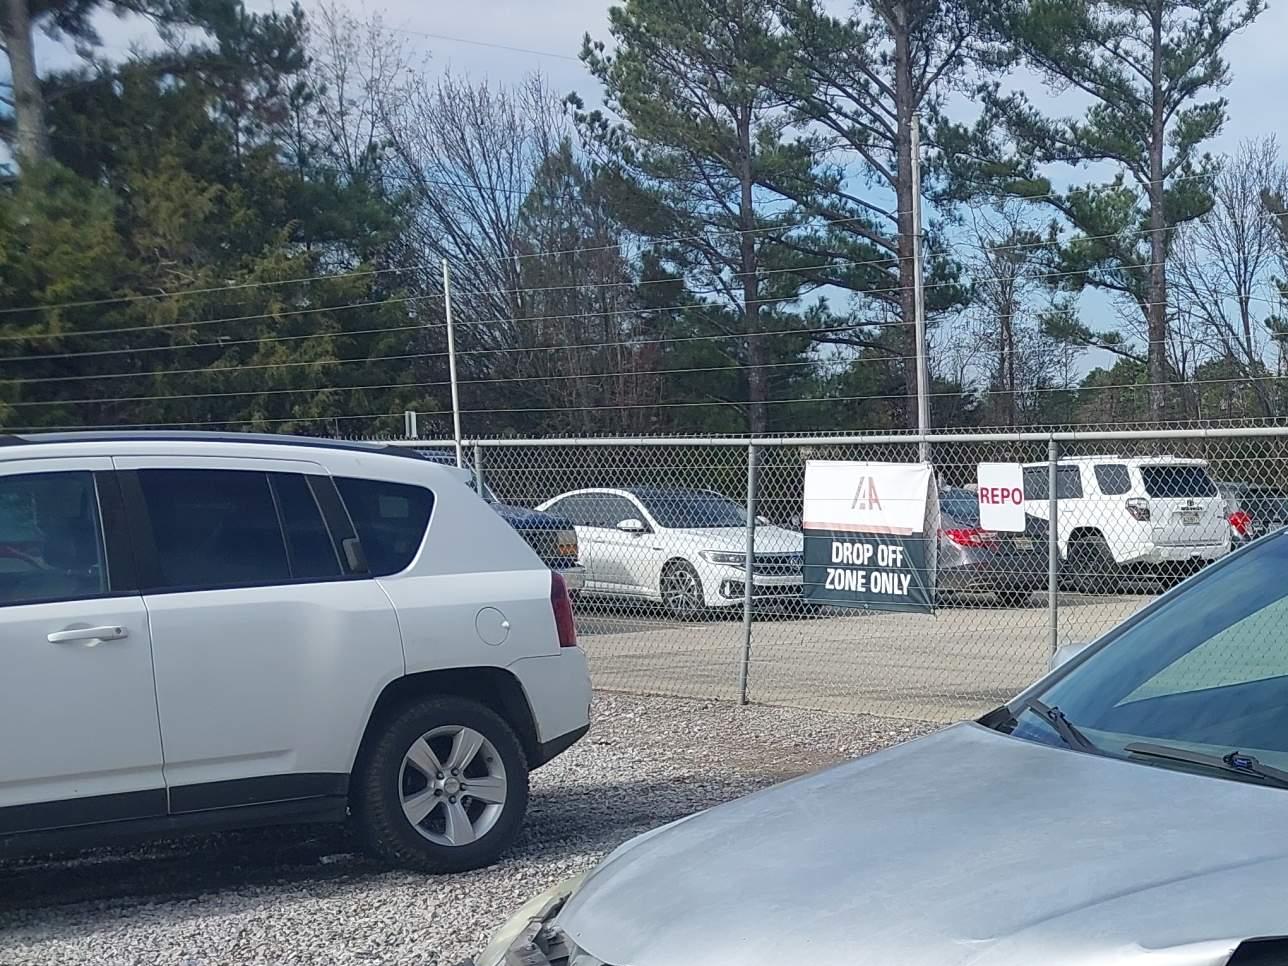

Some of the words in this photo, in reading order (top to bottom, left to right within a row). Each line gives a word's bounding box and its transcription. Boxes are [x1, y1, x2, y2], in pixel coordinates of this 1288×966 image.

[980, 487, 1023, 505] REPO
[831, 541, 873, 566] DROP
[877, 544, 904, 568] OFF
[825, 568, 867, 593] ZONE
[870, 571, 912, 596] ONLY
